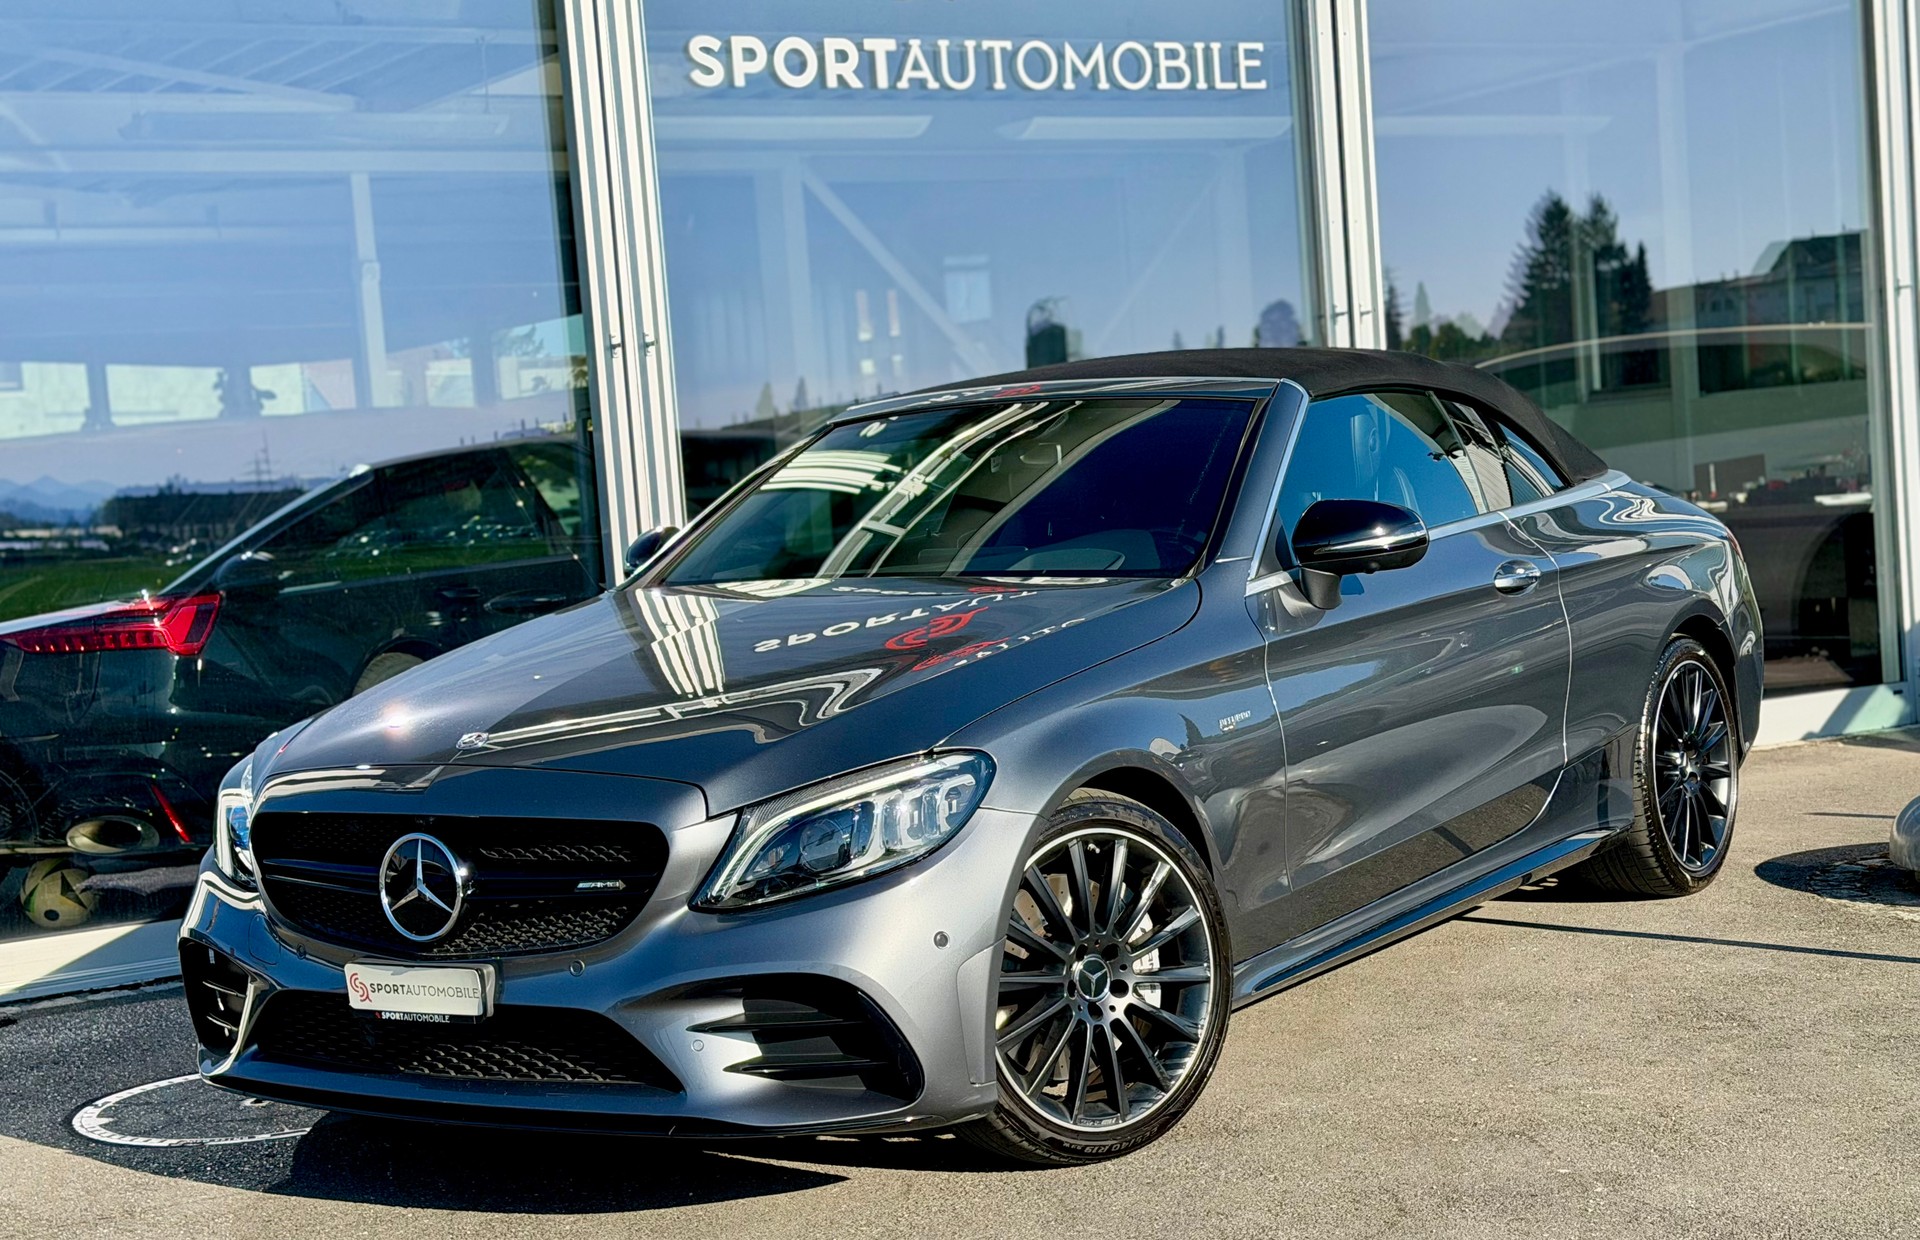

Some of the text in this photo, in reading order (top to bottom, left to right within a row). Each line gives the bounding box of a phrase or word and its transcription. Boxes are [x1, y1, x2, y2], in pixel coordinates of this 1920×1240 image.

[688, 35, 1267, 90] SPORTAUTOMOBILE
[369, 983, 480, 999] SPORTAUTOMOBILE
[381, 1011, 450, 1023] SPORTAUTOMOBILE
